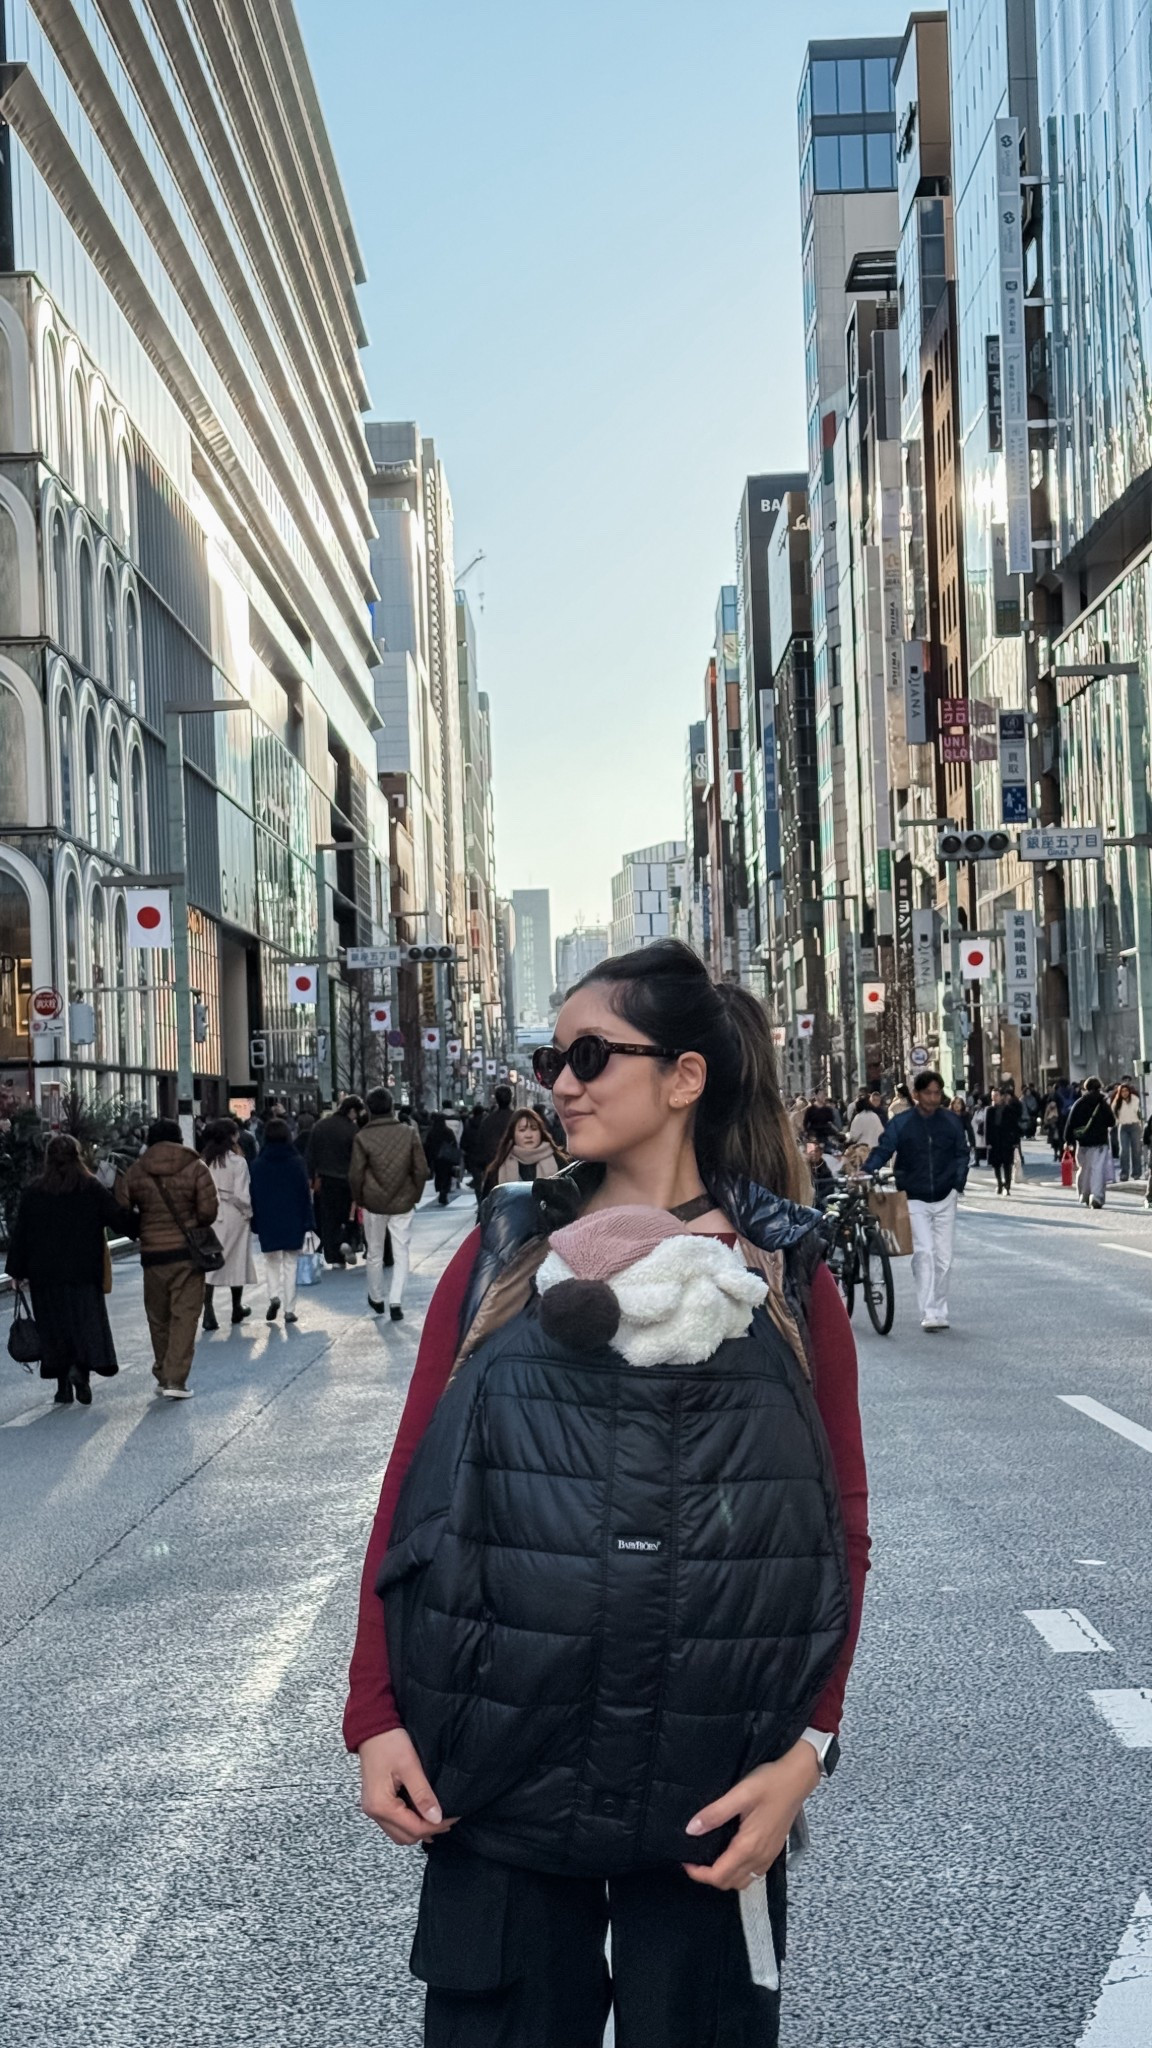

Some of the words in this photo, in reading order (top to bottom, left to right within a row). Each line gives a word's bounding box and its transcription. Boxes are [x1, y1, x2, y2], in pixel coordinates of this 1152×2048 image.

[909, 666, 921, 718] DIANA
[943, 736, 966, 747] UNI
[944, 748, 968, 759] QLO
[1026, 834, 1098, 849] 銀座五丁目
[1047, 848, 1068, 856] Ginza
[1013, 914, 1027, 979] 岩崎眼鏡店
